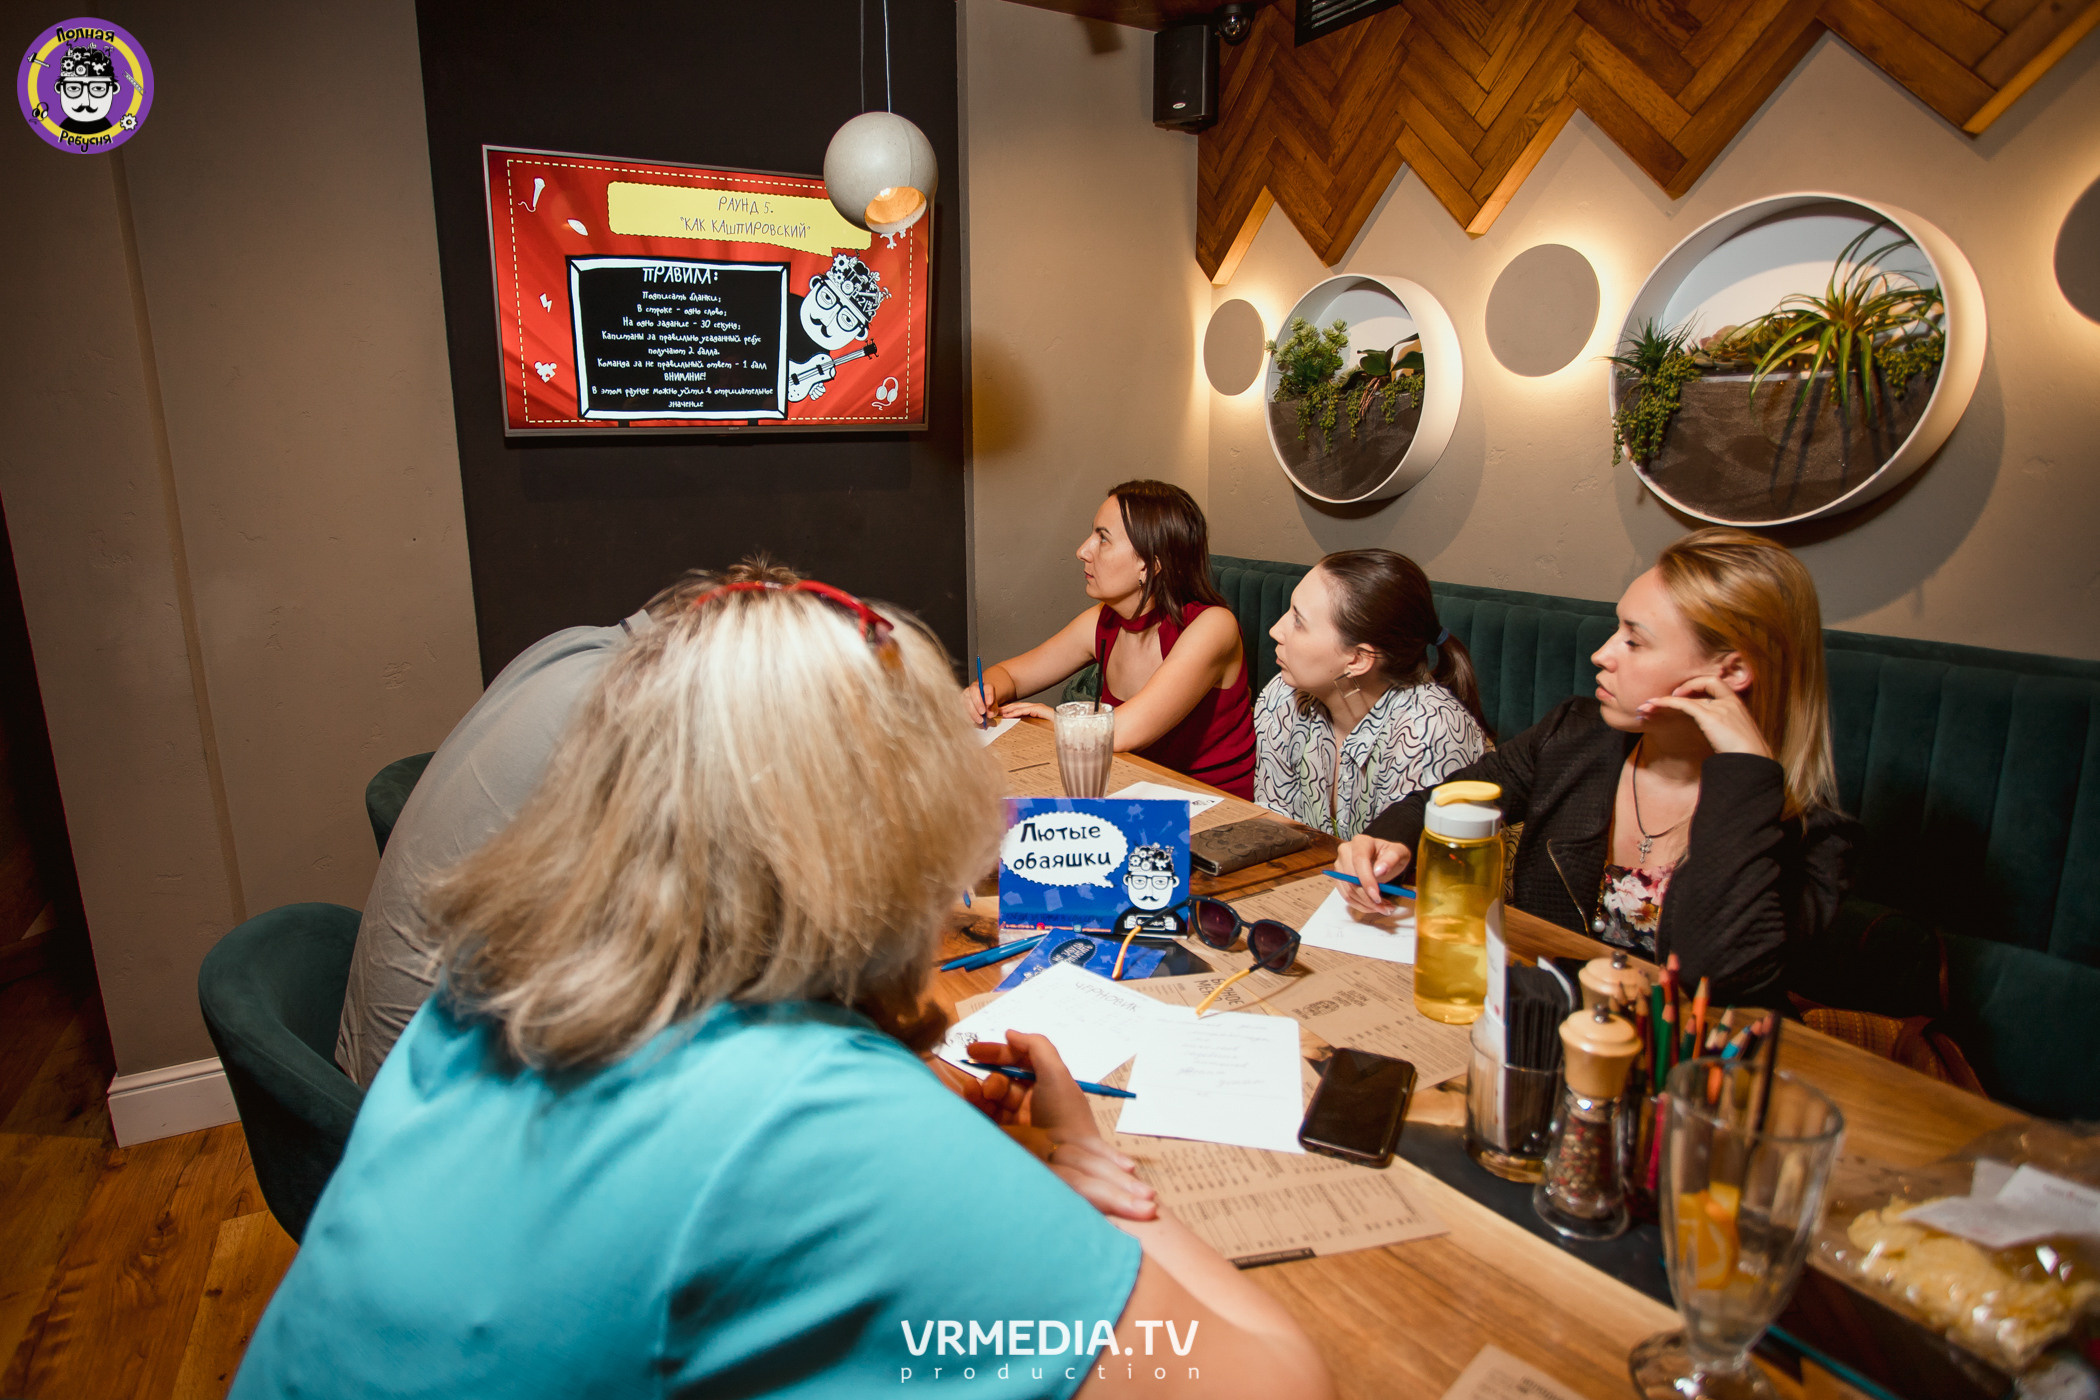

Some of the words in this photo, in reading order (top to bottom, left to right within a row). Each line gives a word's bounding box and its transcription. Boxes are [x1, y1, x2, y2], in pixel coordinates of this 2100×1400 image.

[718, 196, 759, 215] РАУНД
[764, 201, 774, 214] 5.
[642, 291, 687, 302] Подписать
[637, 304, 643, 313] В
[645, 307, 673, 316] строке
[684, 307, 701, 315] одно
[622, 316, 634, 327] На
[636, 319, 654, 328] одно
[657, 320, 689, 328] задание
[701, 319, 711, 329] 30
[601, 330, 644, 341] Капитаны
[647, 333, 656, 341] за
[659, 332, 699, 344] правильно
[648, 347, 686, 357] получают
[688, 346, 695, 355] 2
[597, 357, 630, 369] Команда
[645, 360, 654, 368] не
[657, 360, 704, 371] правильный
[706, 360, 732, 369] ответ
[743, 360, 748, 369] 1
[750, 360, 768, 370] балл
[592, 385, 598, 395] В
[601, 388, 622, 396] этом
[625, 387, 650, 398] раунде
[652, 387, 678, 396] можно
[677, 386, 704, 398] уйти
[714, 387, 774, 398] отрицательное
[668, 401, 704, 409] значение
[1020, 822, 1101, 843] Лютые
[1013, 851, 1112, 871] обаяшки
